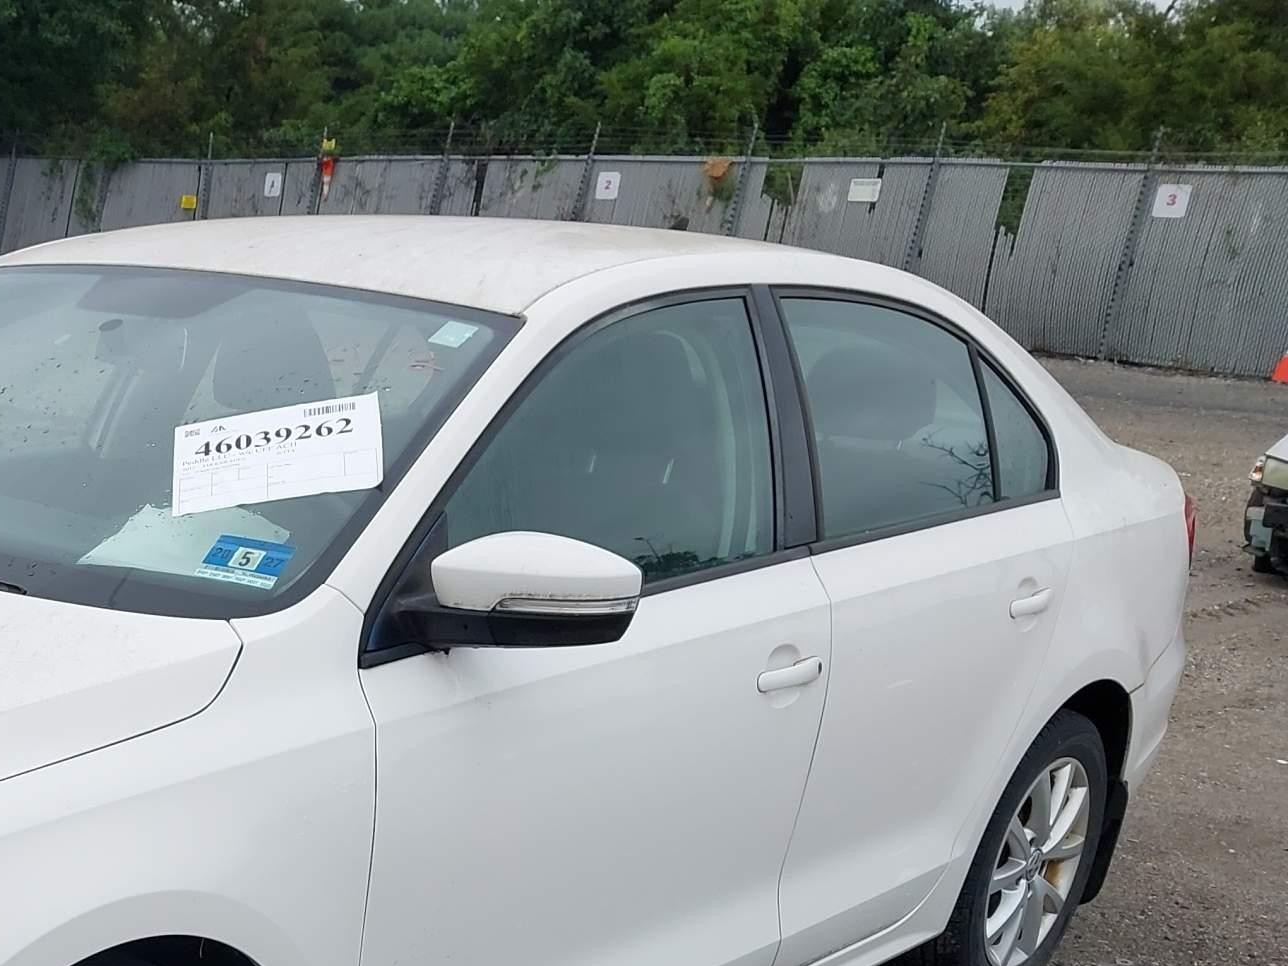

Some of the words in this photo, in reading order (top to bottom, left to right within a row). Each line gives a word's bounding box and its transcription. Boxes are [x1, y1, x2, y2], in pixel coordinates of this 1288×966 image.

[604, 180, 612, 190] 2
[1166, 193, 1177, 206] 3
[194, 418, 354, 456] 46039262
[238, 551, 255, 567] 5
